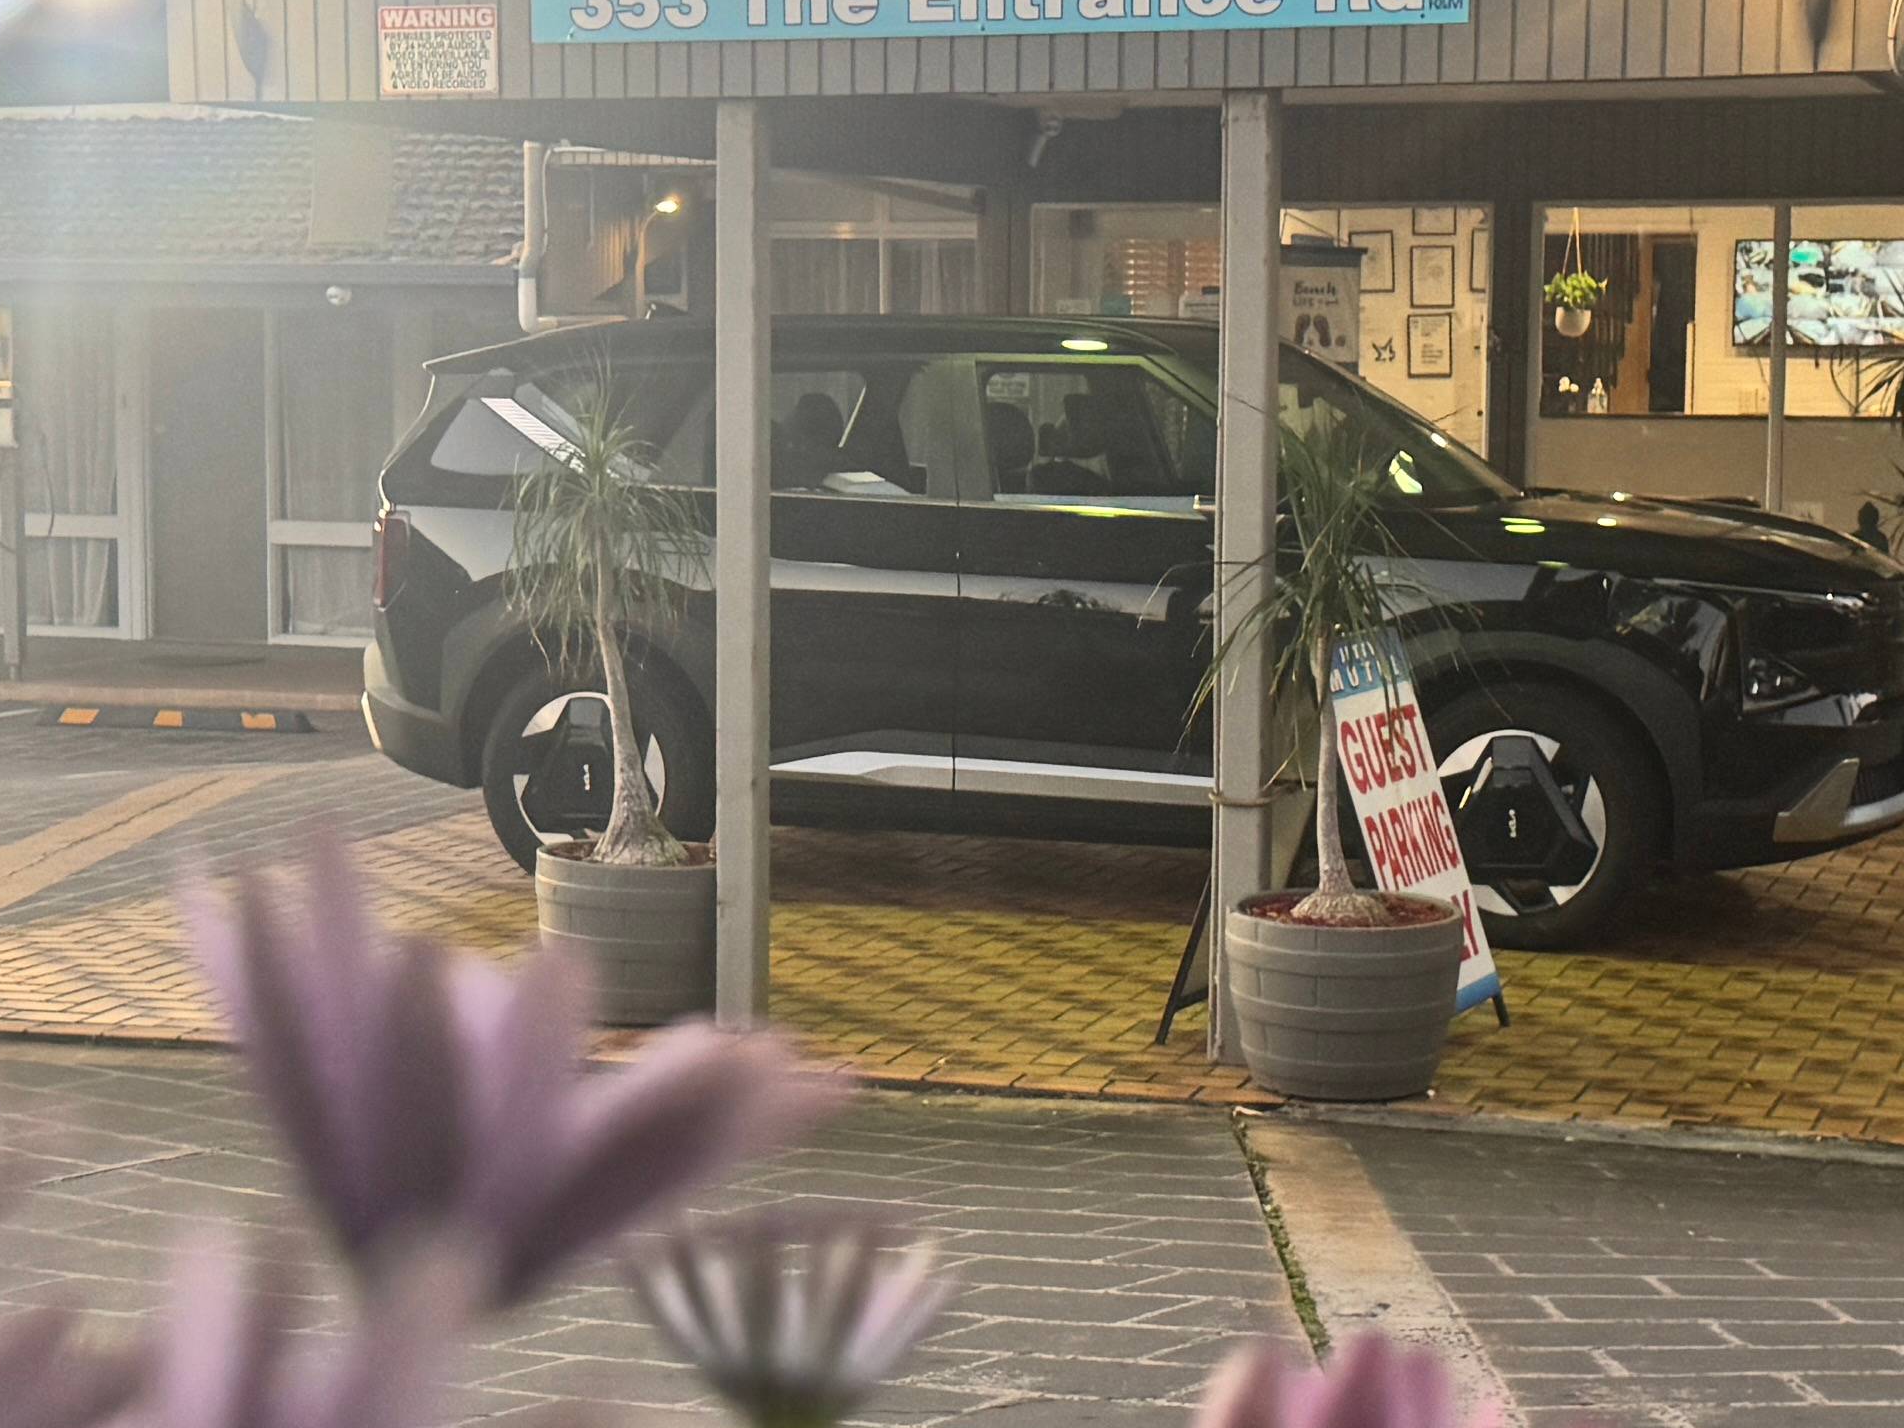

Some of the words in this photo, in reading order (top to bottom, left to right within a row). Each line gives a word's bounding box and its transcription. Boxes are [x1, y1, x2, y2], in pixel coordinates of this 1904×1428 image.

[382, 8, 494, 28] WARNING
[434, 30, 492, 40] PROTECTED
[417, 40, 445, 50] HOUR
[447, 40, 478, 50] AUDIO
[461, 59, 482, 70] YOU
[426, 70, 439, 79] TO
[400, 80, 430, 89] VIDEO
[432, 79, 486, 89] RECORDED
[1340, 703, 1428, 795] GUEST
[1364, 790, 1461, 892] PARKING
